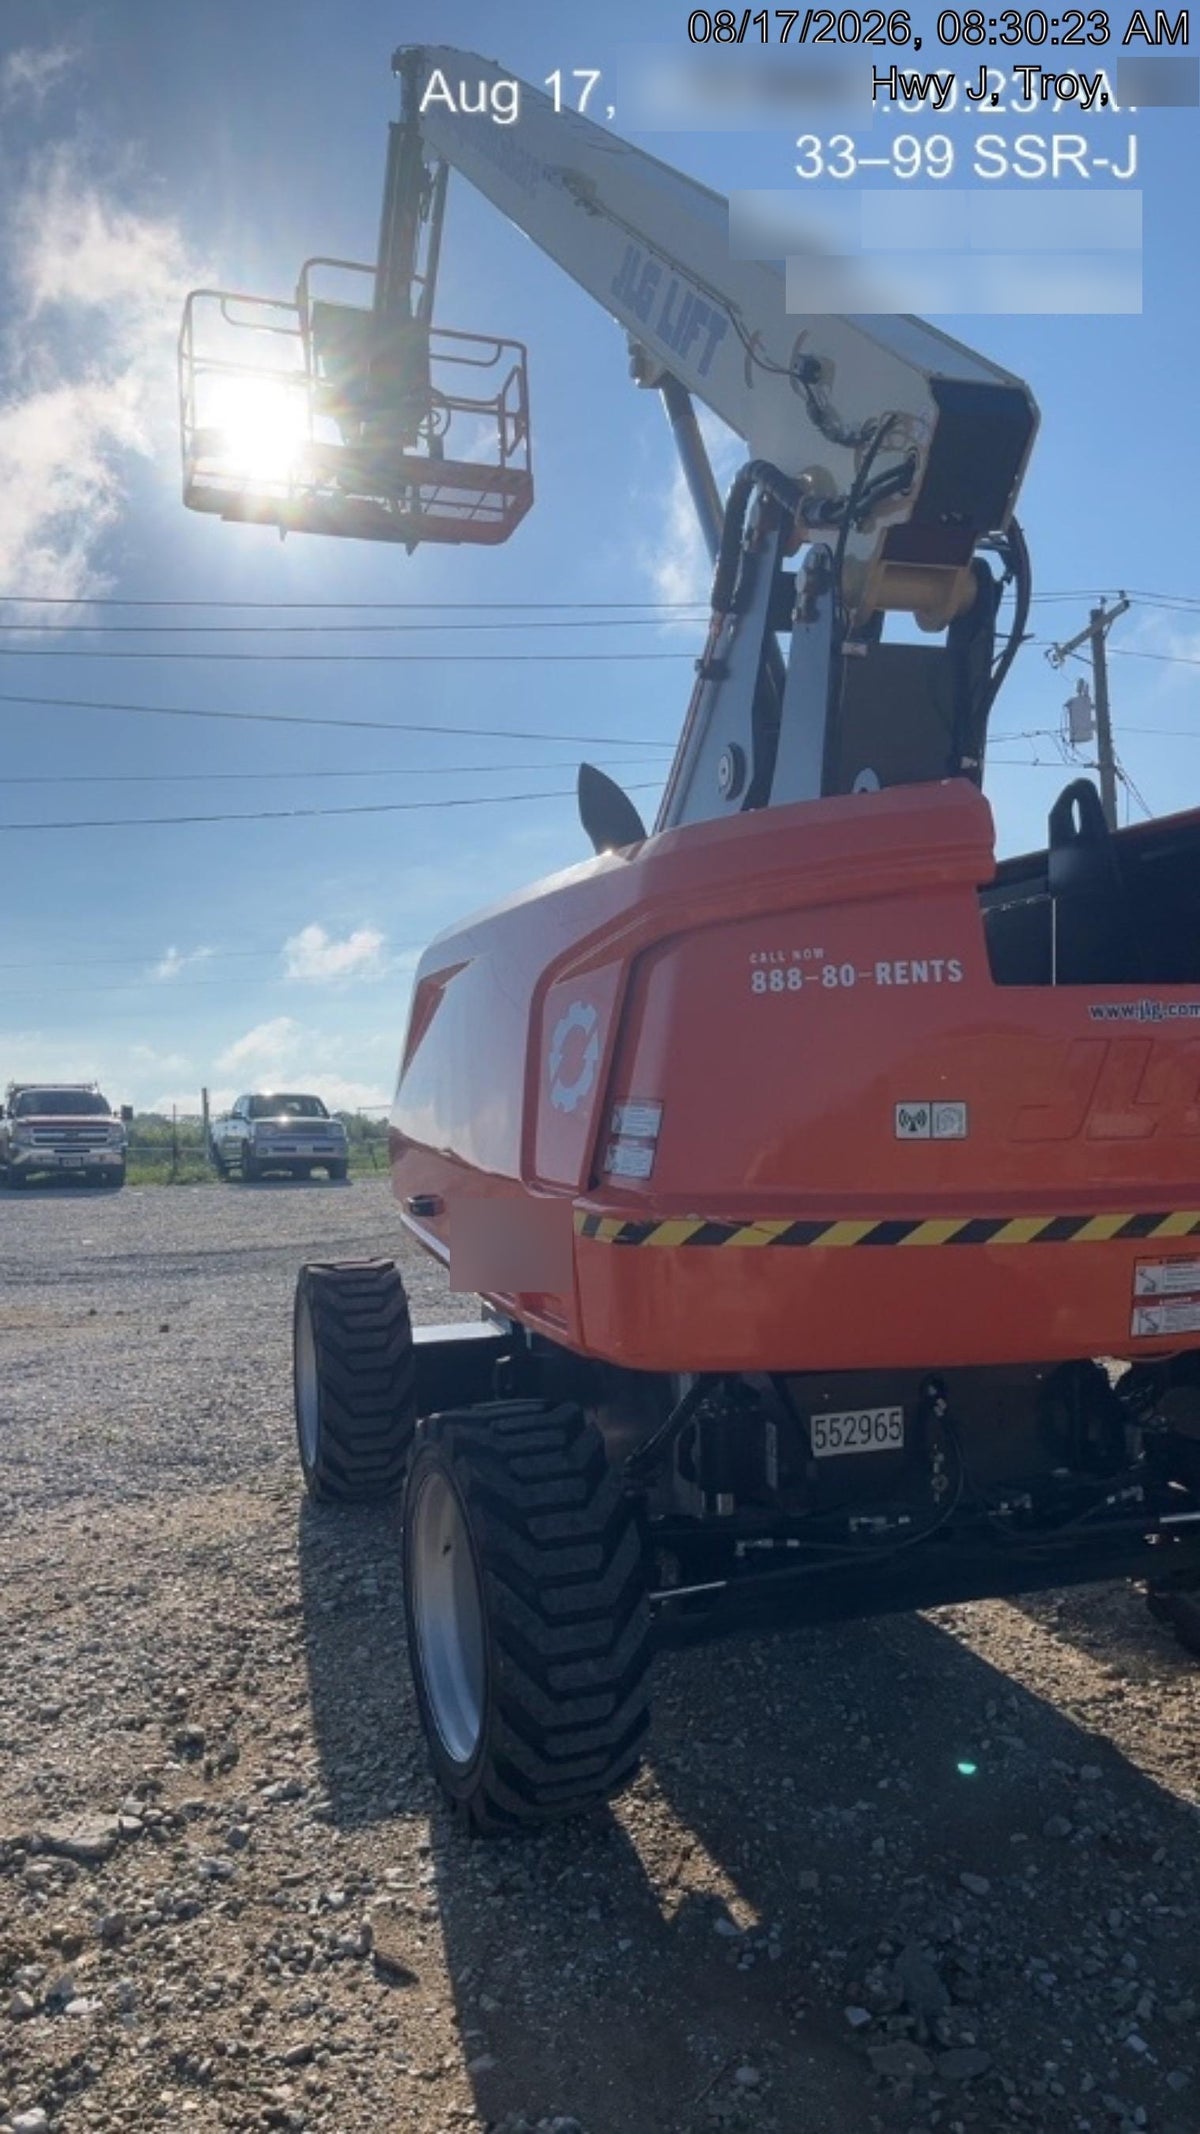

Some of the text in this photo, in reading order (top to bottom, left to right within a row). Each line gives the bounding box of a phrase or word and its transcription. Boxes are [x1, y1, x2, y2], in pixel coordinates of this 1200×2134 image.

[656, 278, 729, 377] LIFT
[750, 948, 824, 964] CALL NOW
[752, 959, 964, 994] 888-80-RENTS
[814, 1410, 901, 1450] 552965
